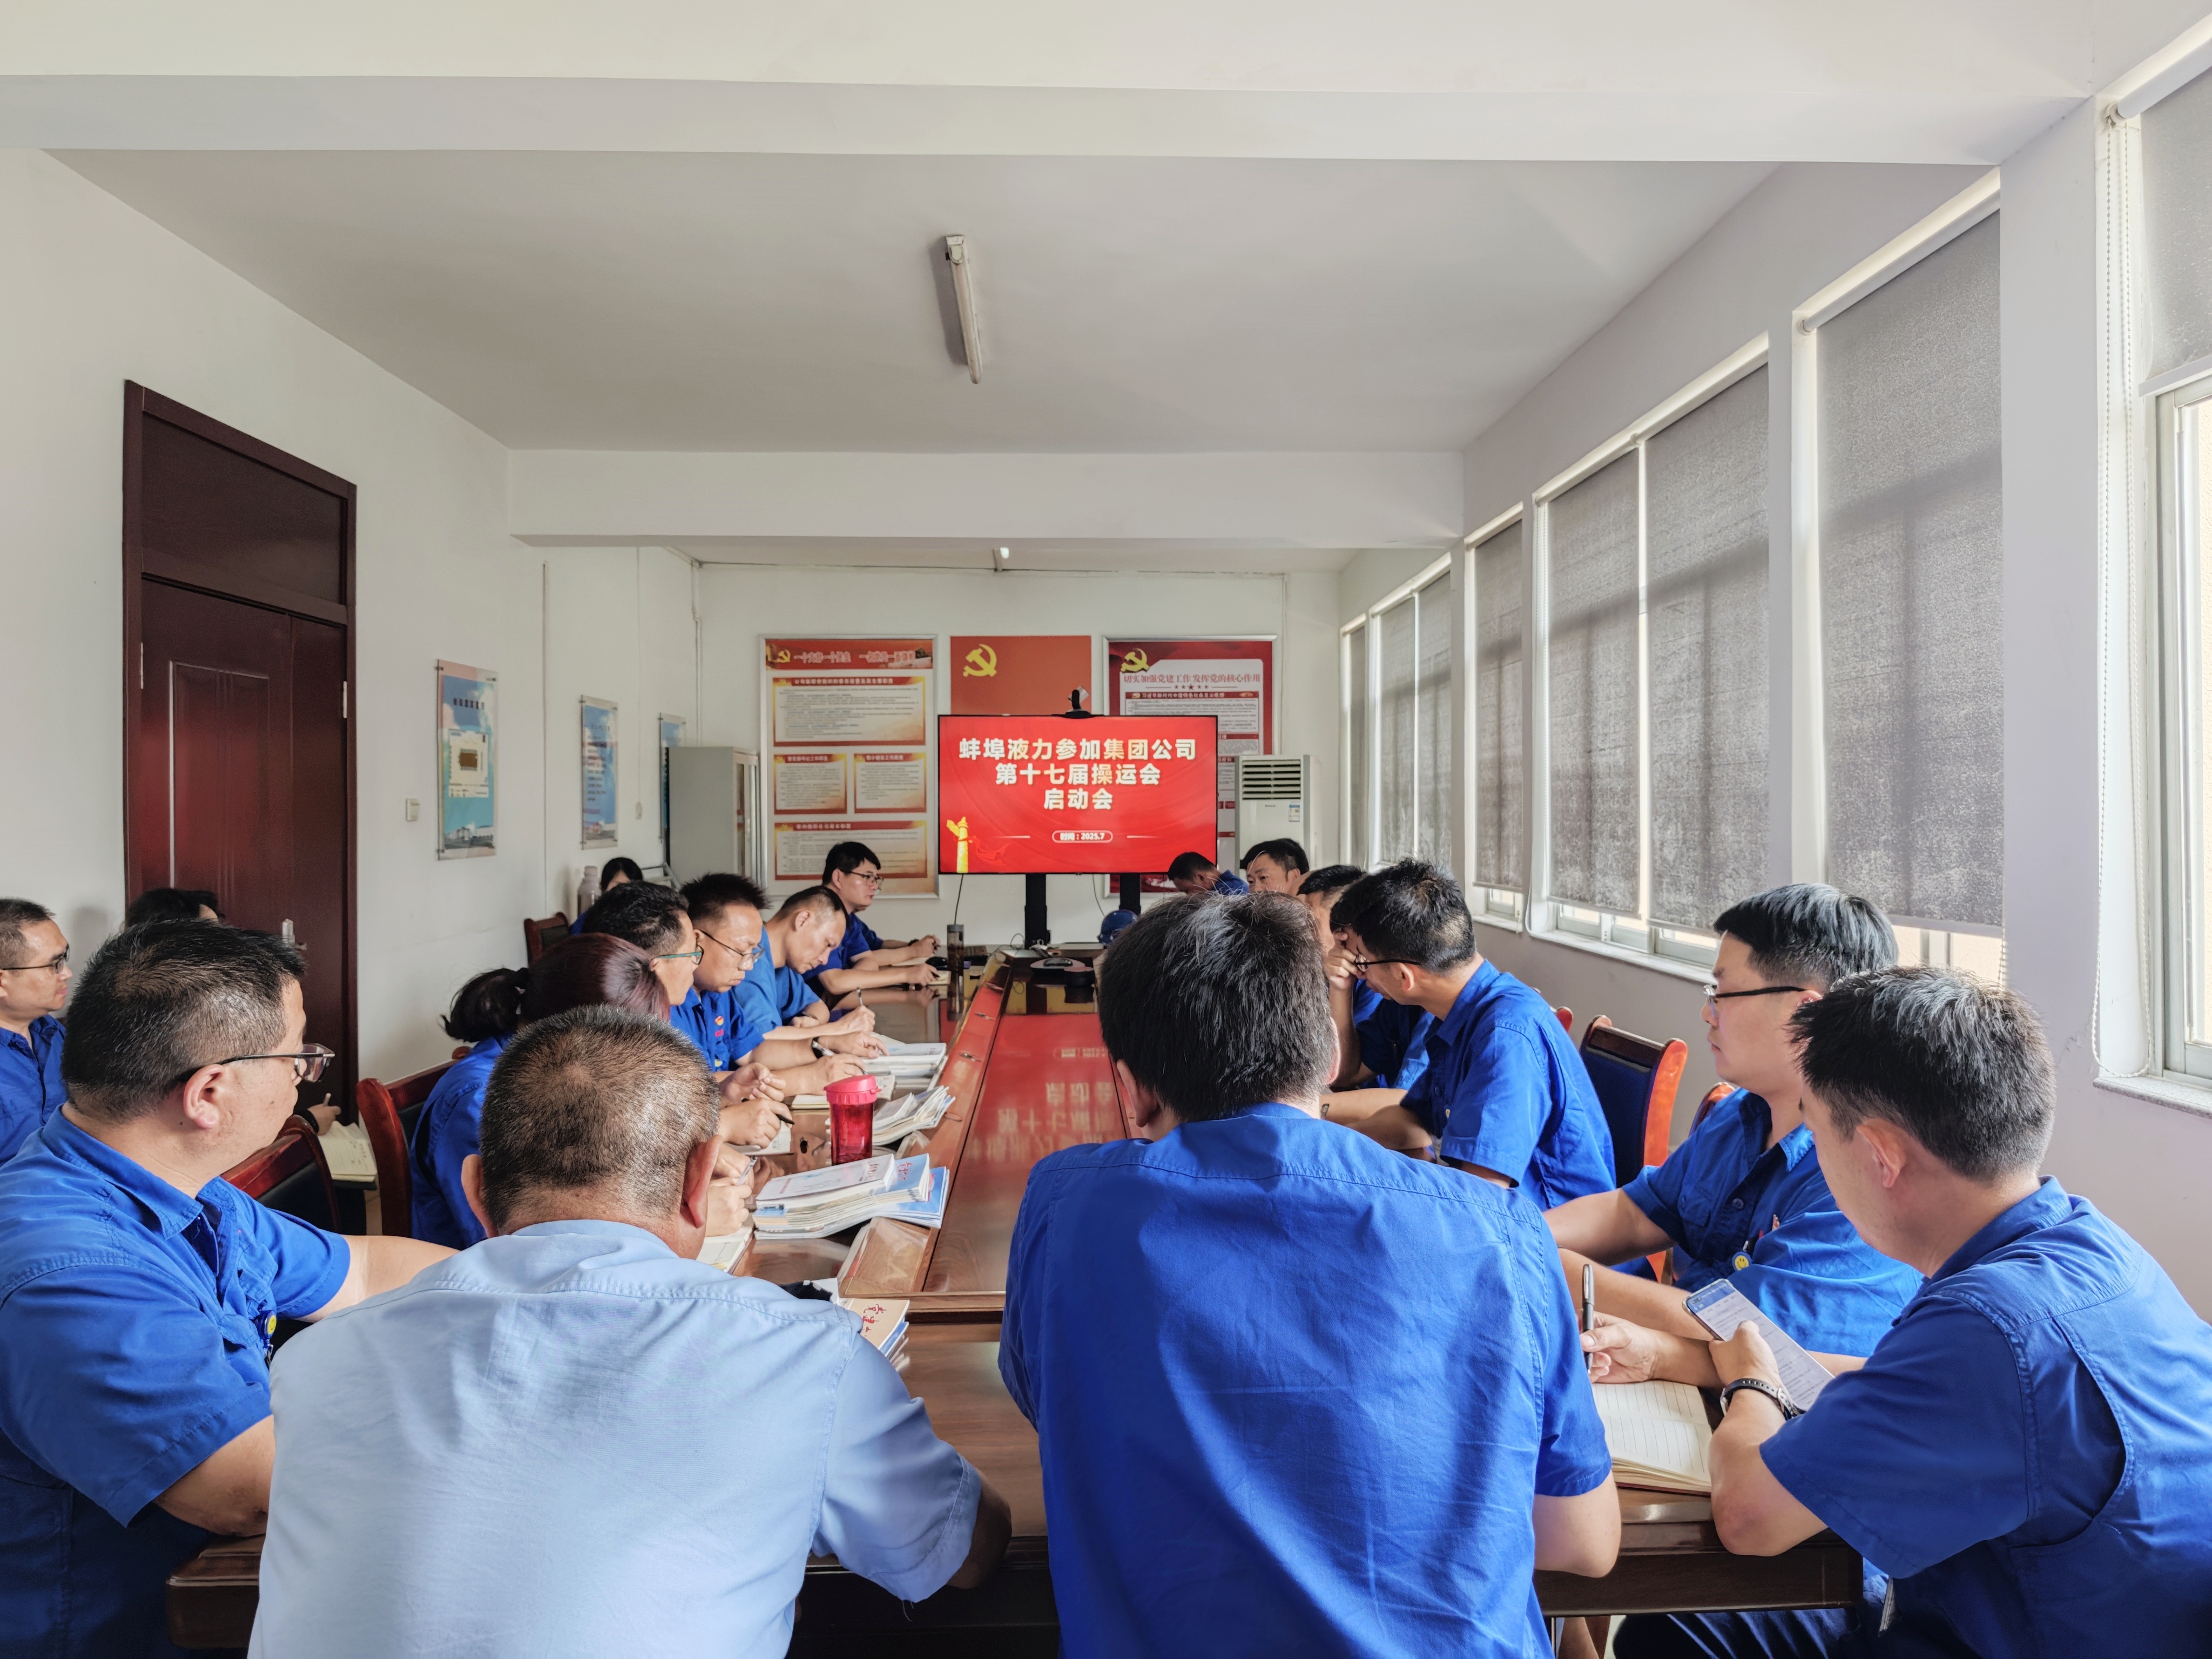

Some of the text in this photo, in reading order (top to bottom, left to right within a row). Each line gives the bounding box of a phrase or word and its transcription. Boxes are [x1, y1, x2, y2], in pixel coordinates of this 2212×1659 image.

[959, 738, 1196, 760] 蚌埠液力参加集团公司
[995, 763, 1161, 786] 第十七届操运会
[1044, 788, 1113, 810] 启动会
